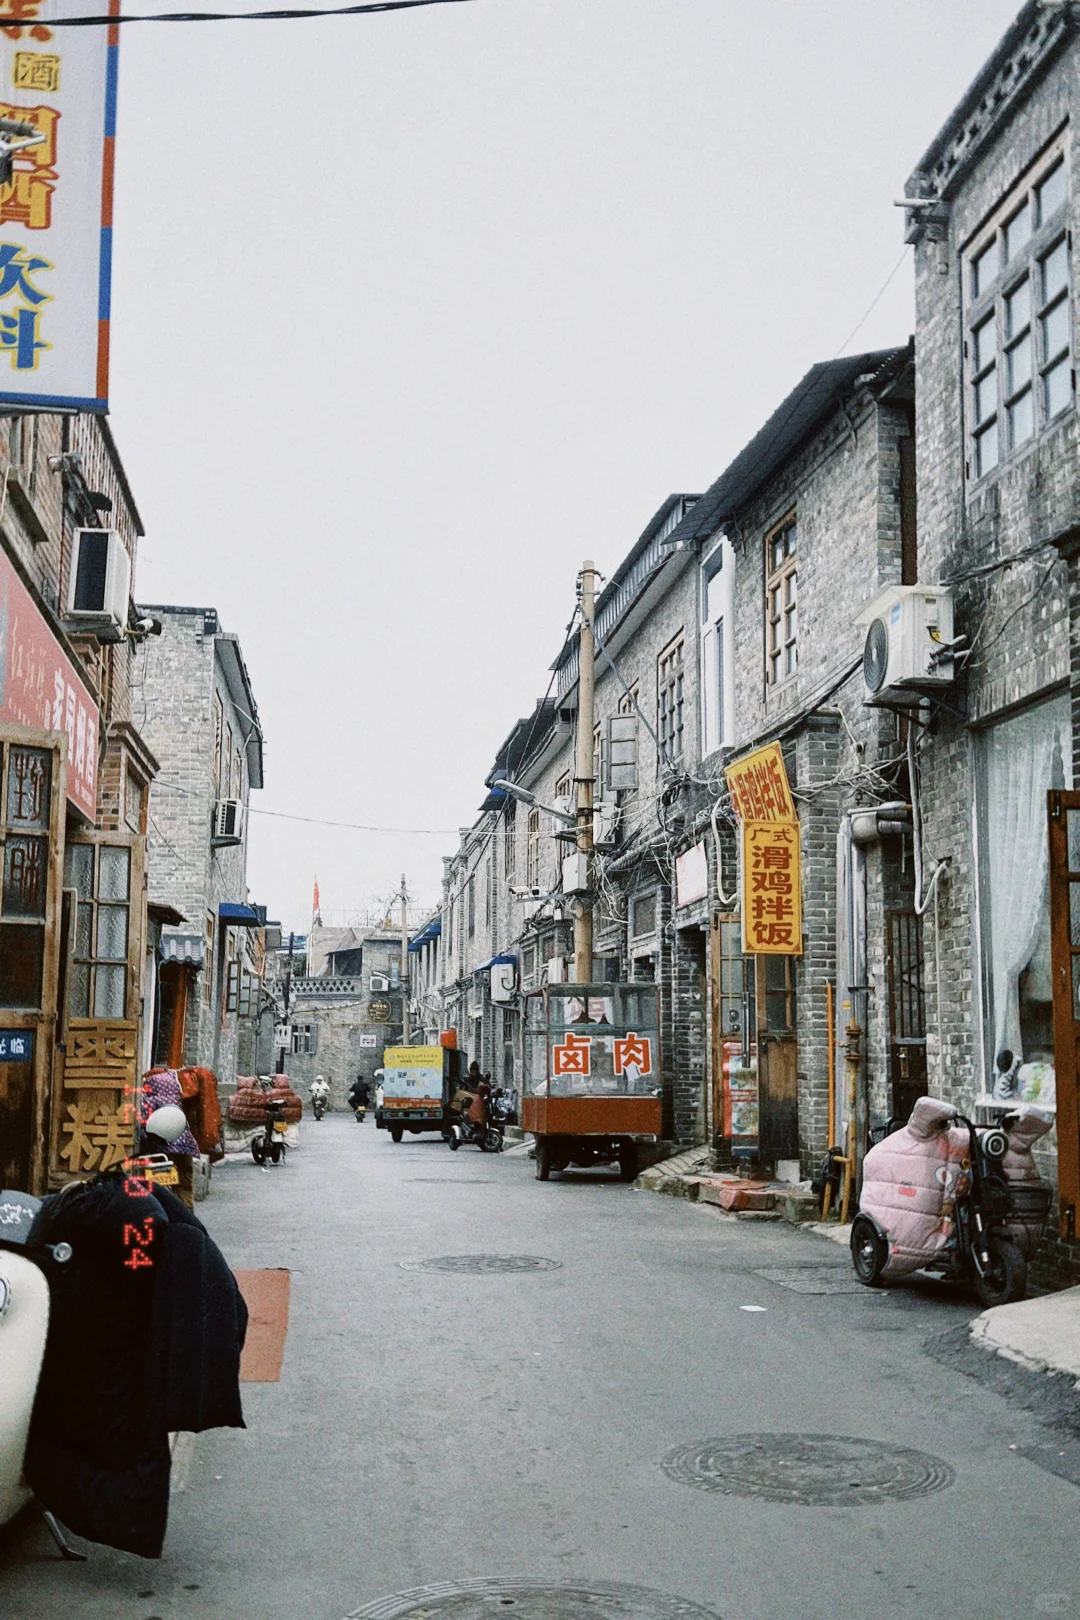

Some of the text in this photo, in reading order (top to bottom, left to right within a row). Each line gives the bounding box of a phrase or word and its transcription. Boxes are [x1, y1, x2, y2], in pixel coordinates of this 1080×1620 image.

[750, 827, 794, 845] 广式
[751, 845, 794, 946] 滑鸡拌饭
[552, 1031, 652, 1076] 卤肉
[60, 1019, 138, 1173] 雪糕
